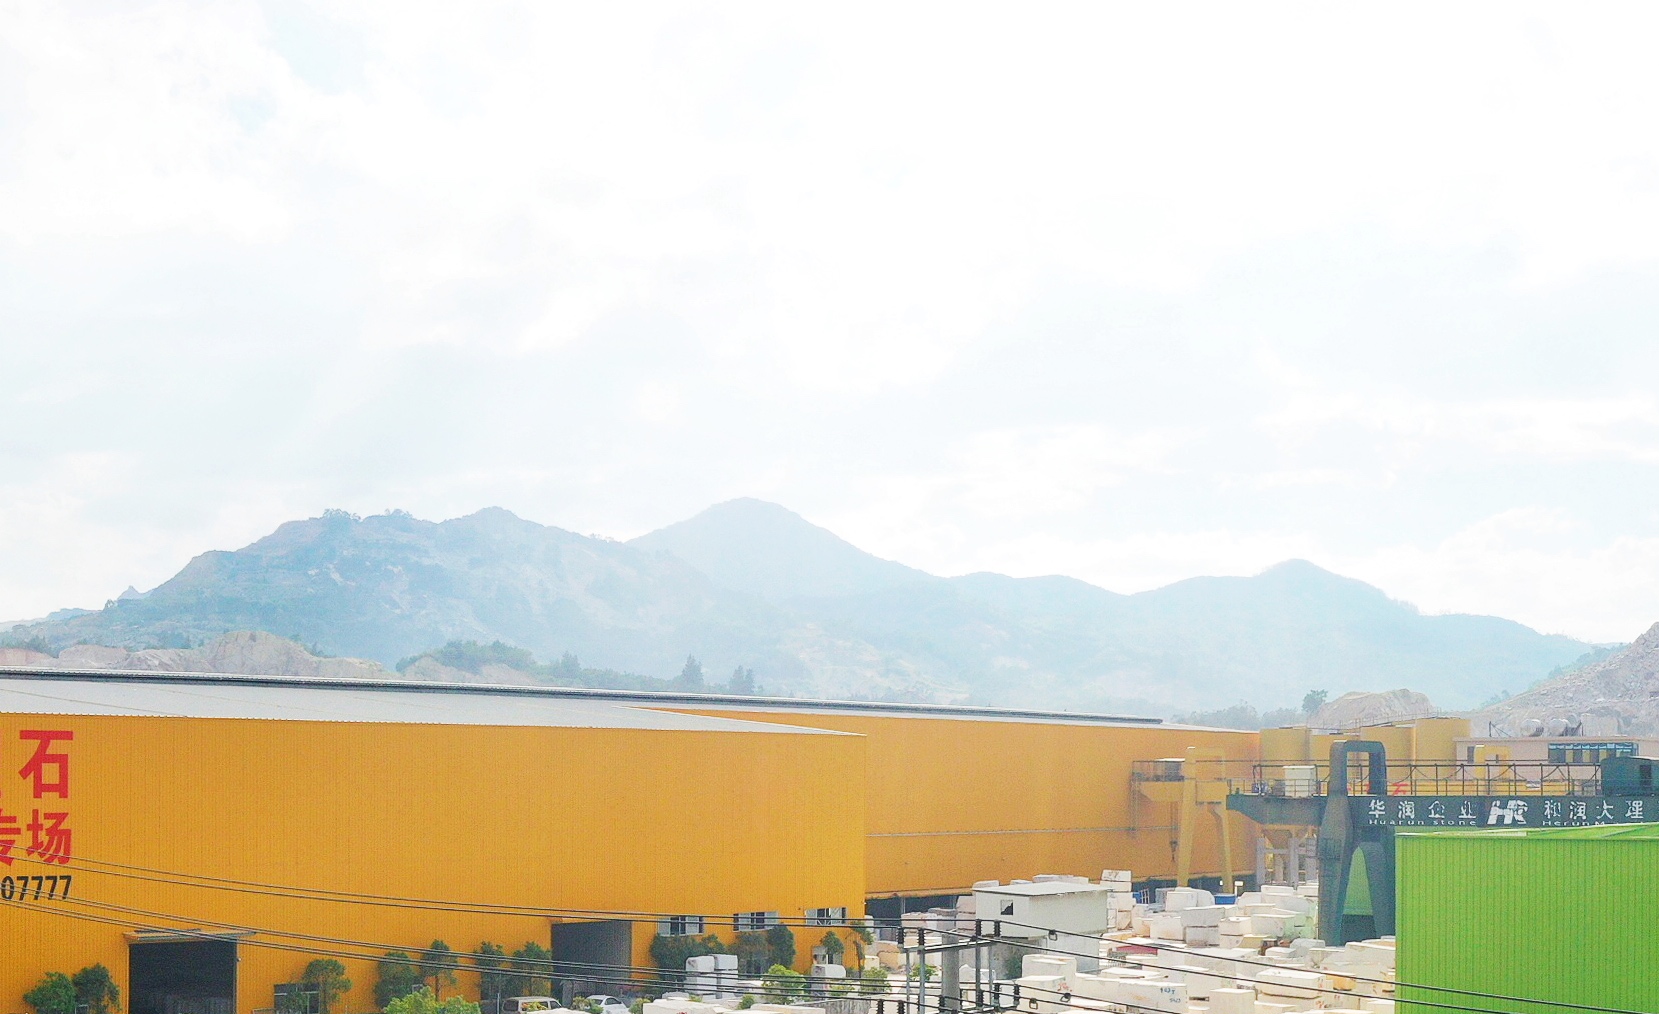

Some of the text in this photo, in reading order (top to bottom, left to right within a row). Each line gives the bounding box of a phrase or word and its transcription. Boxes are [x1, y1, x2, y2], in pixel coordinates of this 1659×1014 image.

[1368, 799, 1477, 819] 华润企业
[0, 875, 73, 901] 07777
